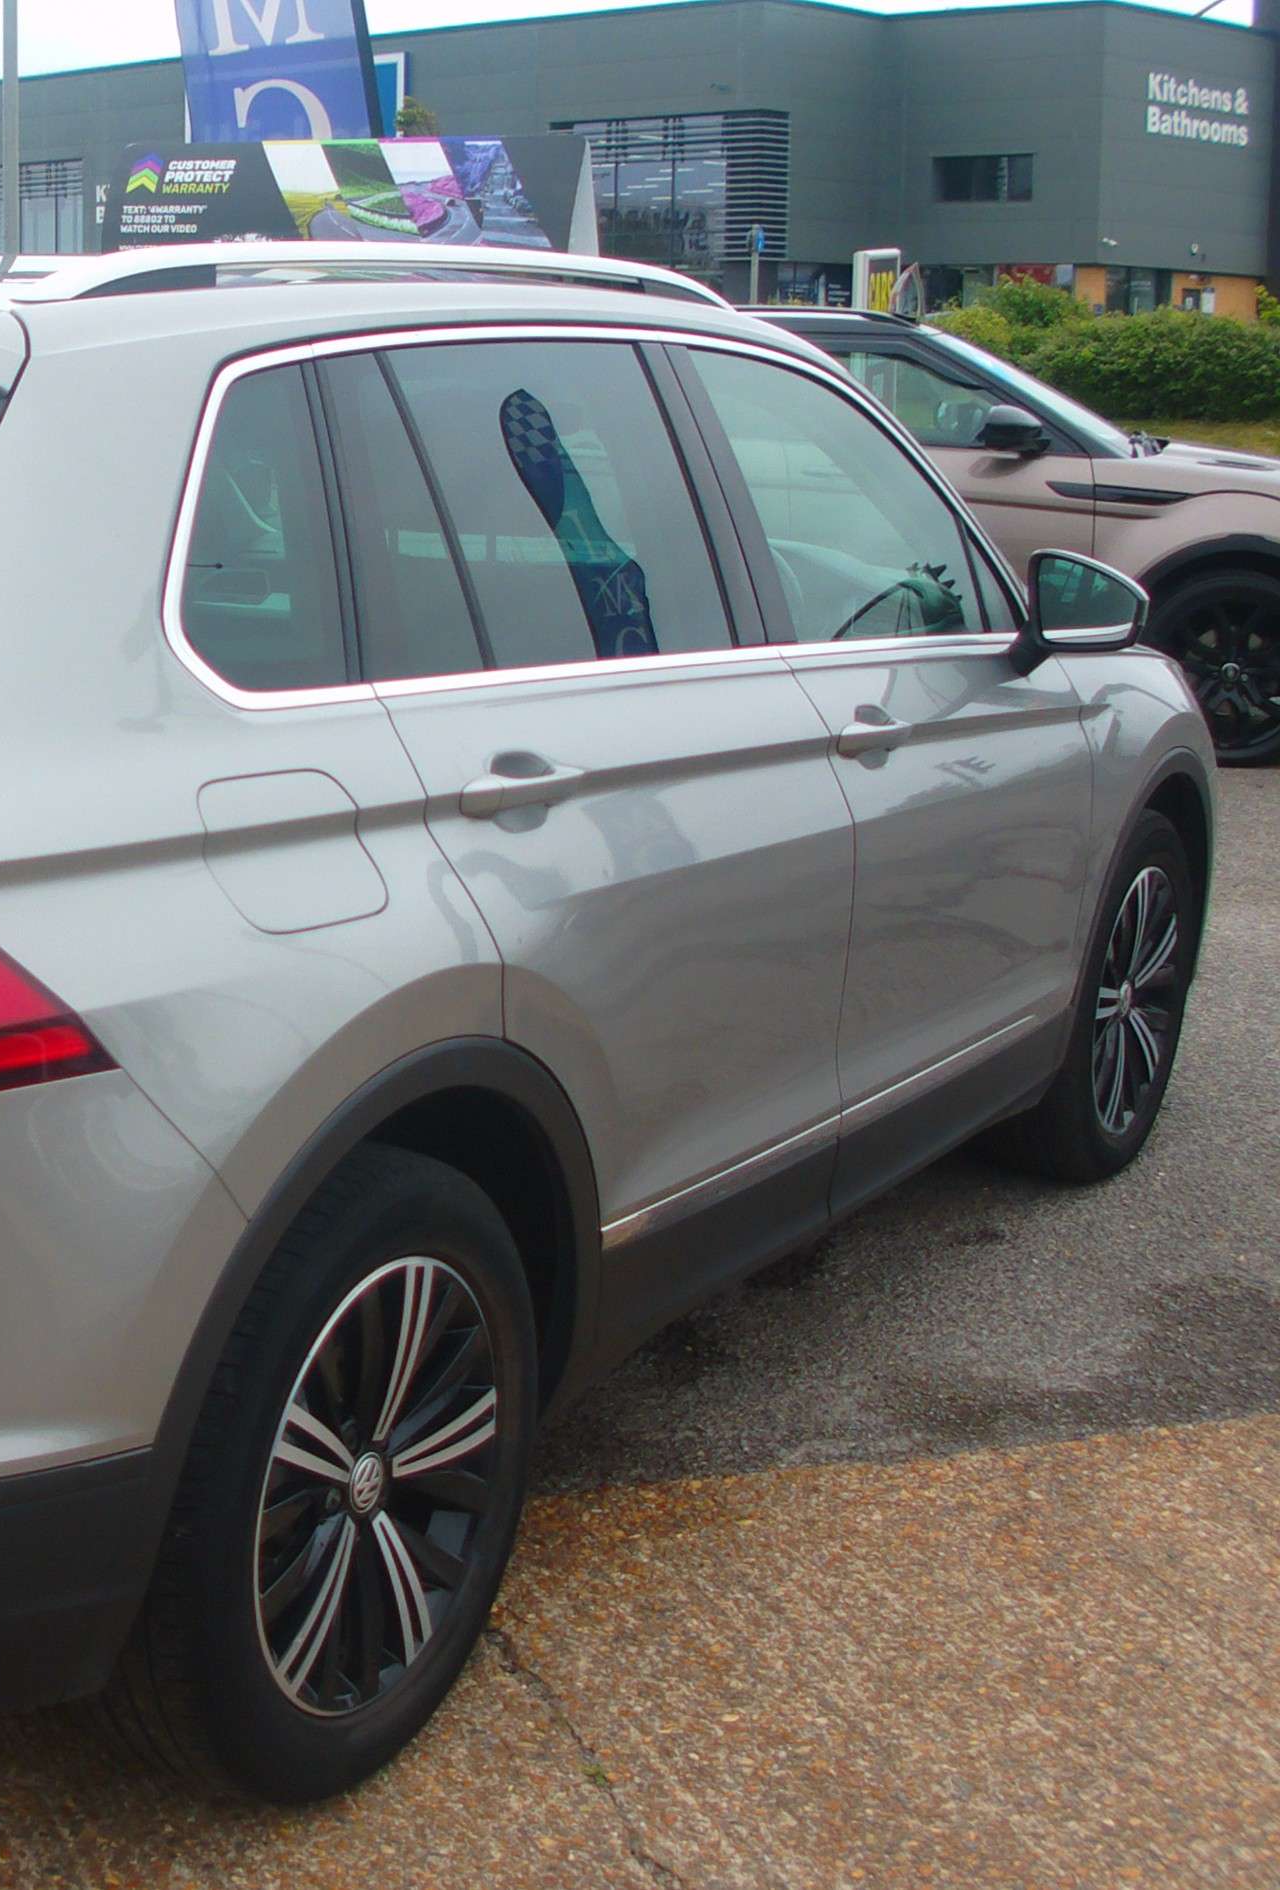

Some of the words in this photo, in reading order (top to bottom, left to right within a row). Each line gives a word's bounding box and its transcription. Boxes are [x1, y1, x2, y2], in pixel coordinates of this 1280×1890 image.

[1148, 72, 1233, 112] Kitchens
[1234, 87, 1249, 115] &
[1147, 105, 1249, 147] Bathrooms
[168, 160, 237, 170] CUSTOMER
[164, 171, 234, 183] PROTECT
[162, 183, 230, 194] WARRANTY
[121, 215, 133, 223] TO
[164, 215, 176, 223] TO
[120, 224, 150, 233] WATCH
[151, 224, 170, 233] OUR
[171, 224, 198, 233] VIDEO
